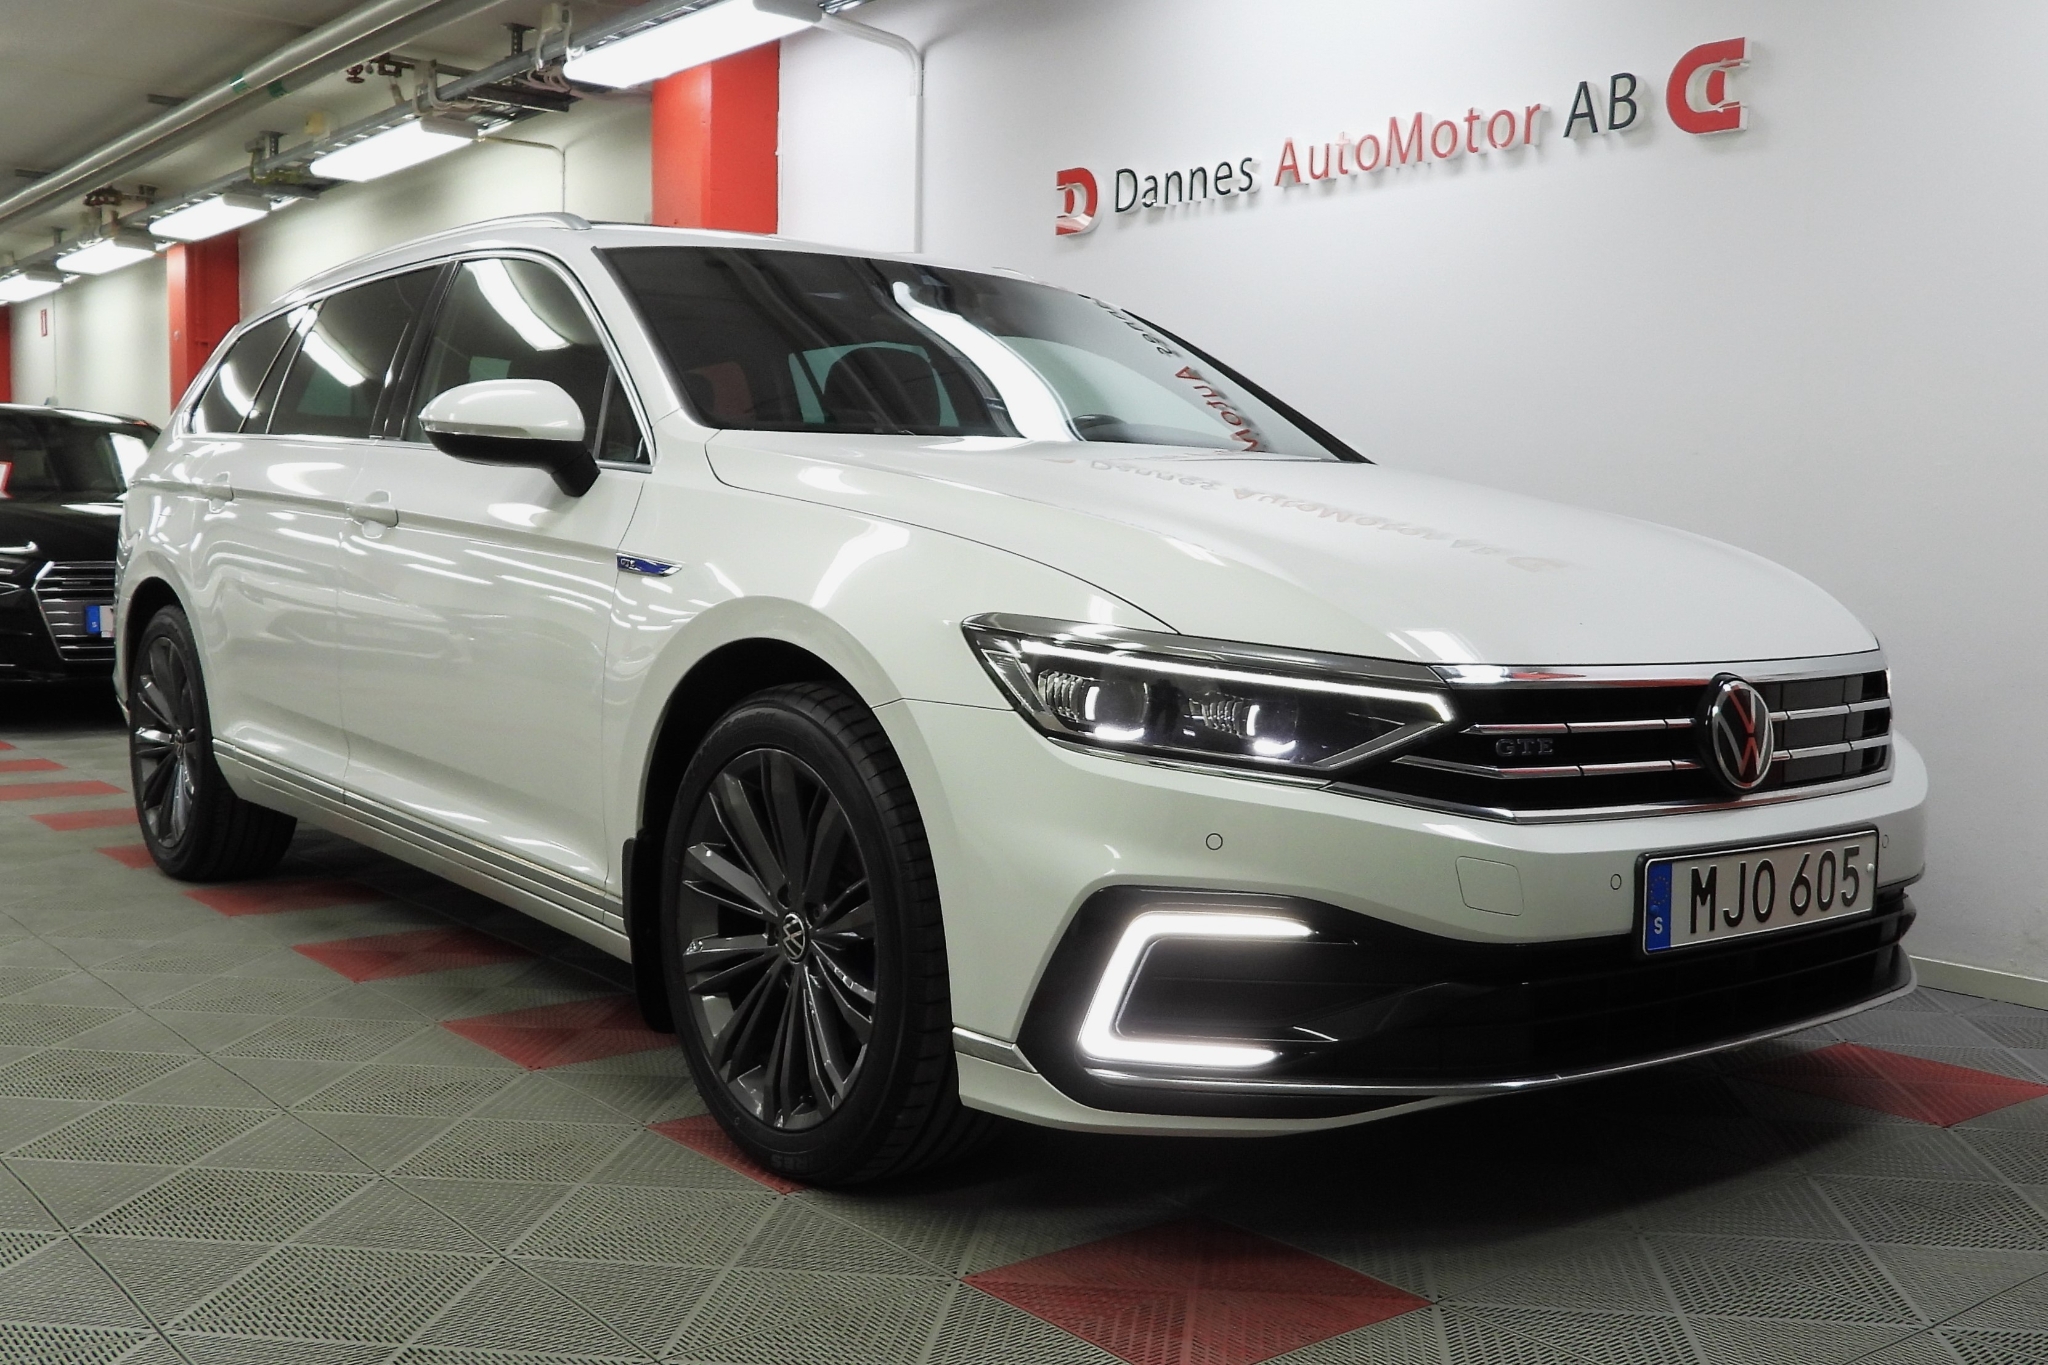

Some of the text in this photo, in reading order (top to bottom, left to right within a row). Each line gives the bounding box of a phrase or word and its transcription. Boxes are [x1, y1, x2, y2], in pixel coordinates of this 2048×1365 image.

[1115, 156, 1253, 213] Dannes
[1274, 103, 1541, 187] AutoMotor
[1563, 72, 1638, 138] AB
[1496, 738, 1554, 756] GTE
[1654, 845, 1860, 935] S MJO 605
